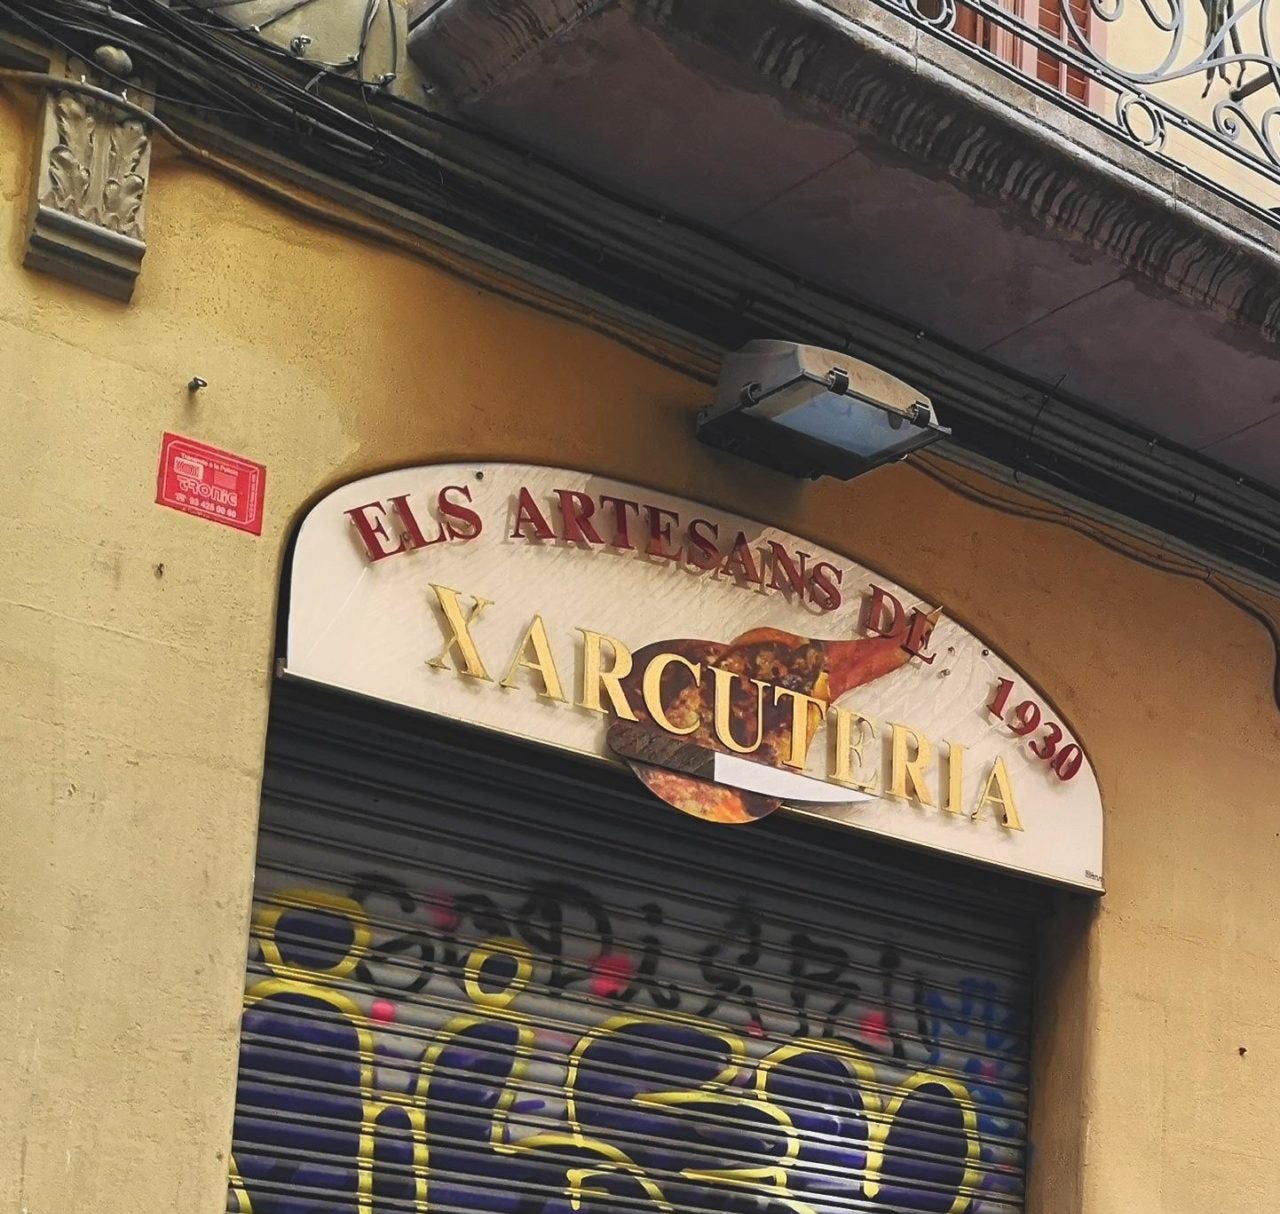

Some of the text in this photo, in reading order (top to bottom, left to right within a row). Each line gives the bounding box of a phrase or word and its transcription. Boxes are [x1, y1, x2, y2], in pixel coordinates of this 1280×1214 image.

[343, 484, 484, 563] ELS
[509, 486, 843, 612] ARTESANS
[986, 677, 1084, 783] 1930
[424, 582, 1025, 833] XARCUTERIA
